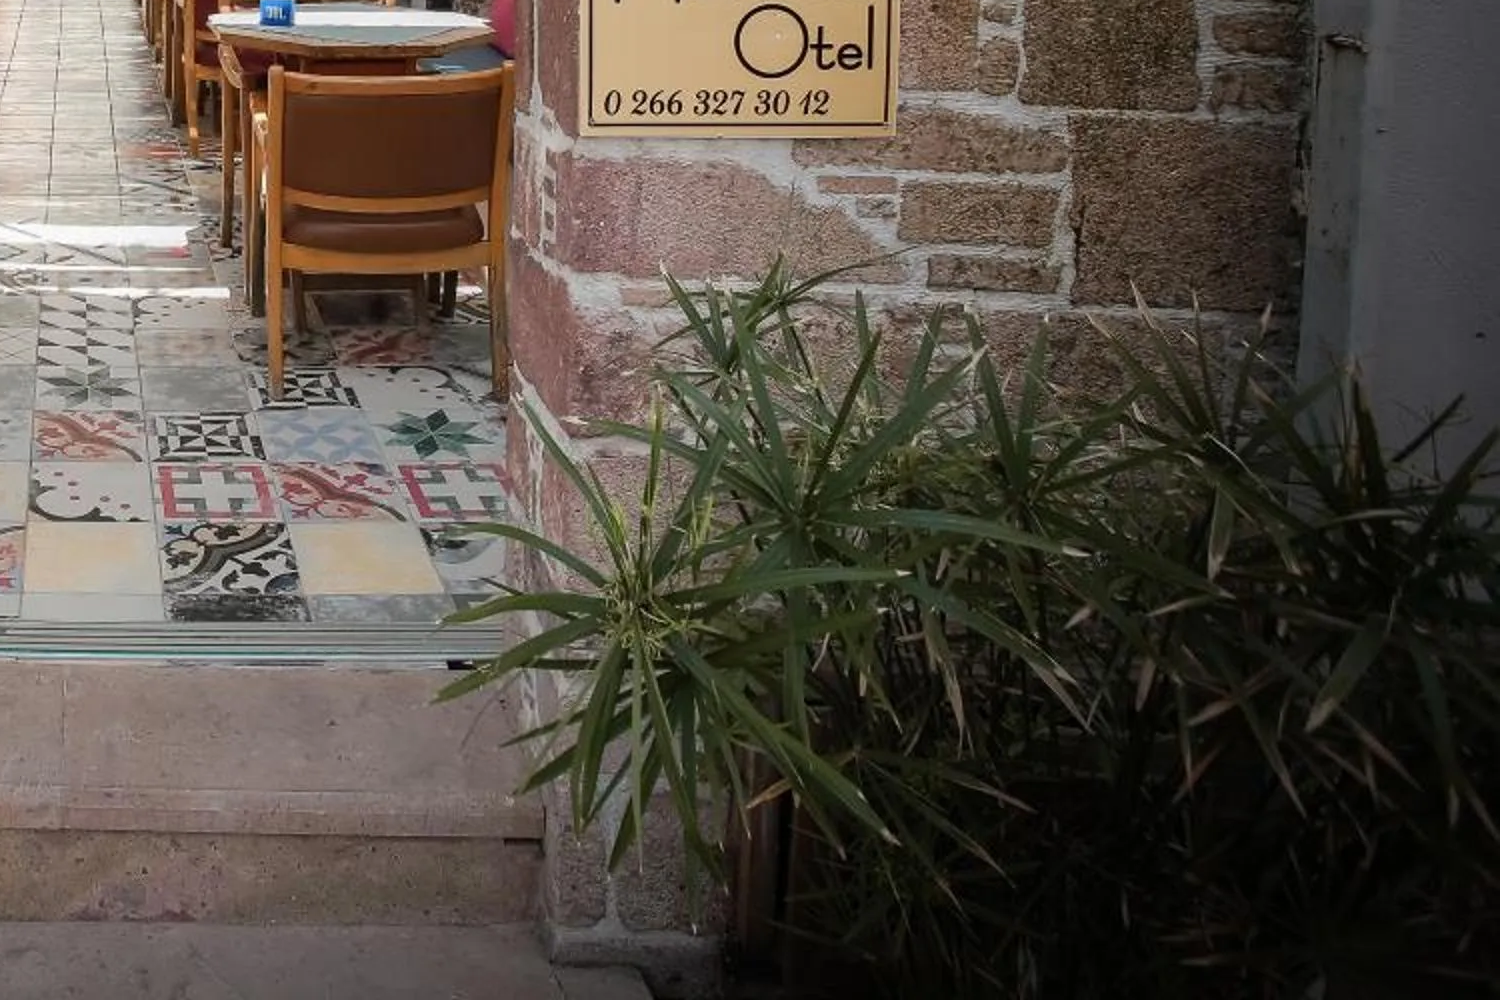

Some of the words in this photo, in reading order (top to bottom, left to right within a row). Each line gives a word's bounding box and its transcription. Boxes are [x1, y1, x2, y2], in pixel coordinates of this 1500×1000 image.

[733, 3, 875, 79] Otel
[603, 89, 622, 116] 0
[631, 89, 684, 116] 266
[693, 89, 746, 116] 327
[753, 89, 790, 116] 30
[798, 89, 831, 116] 12
